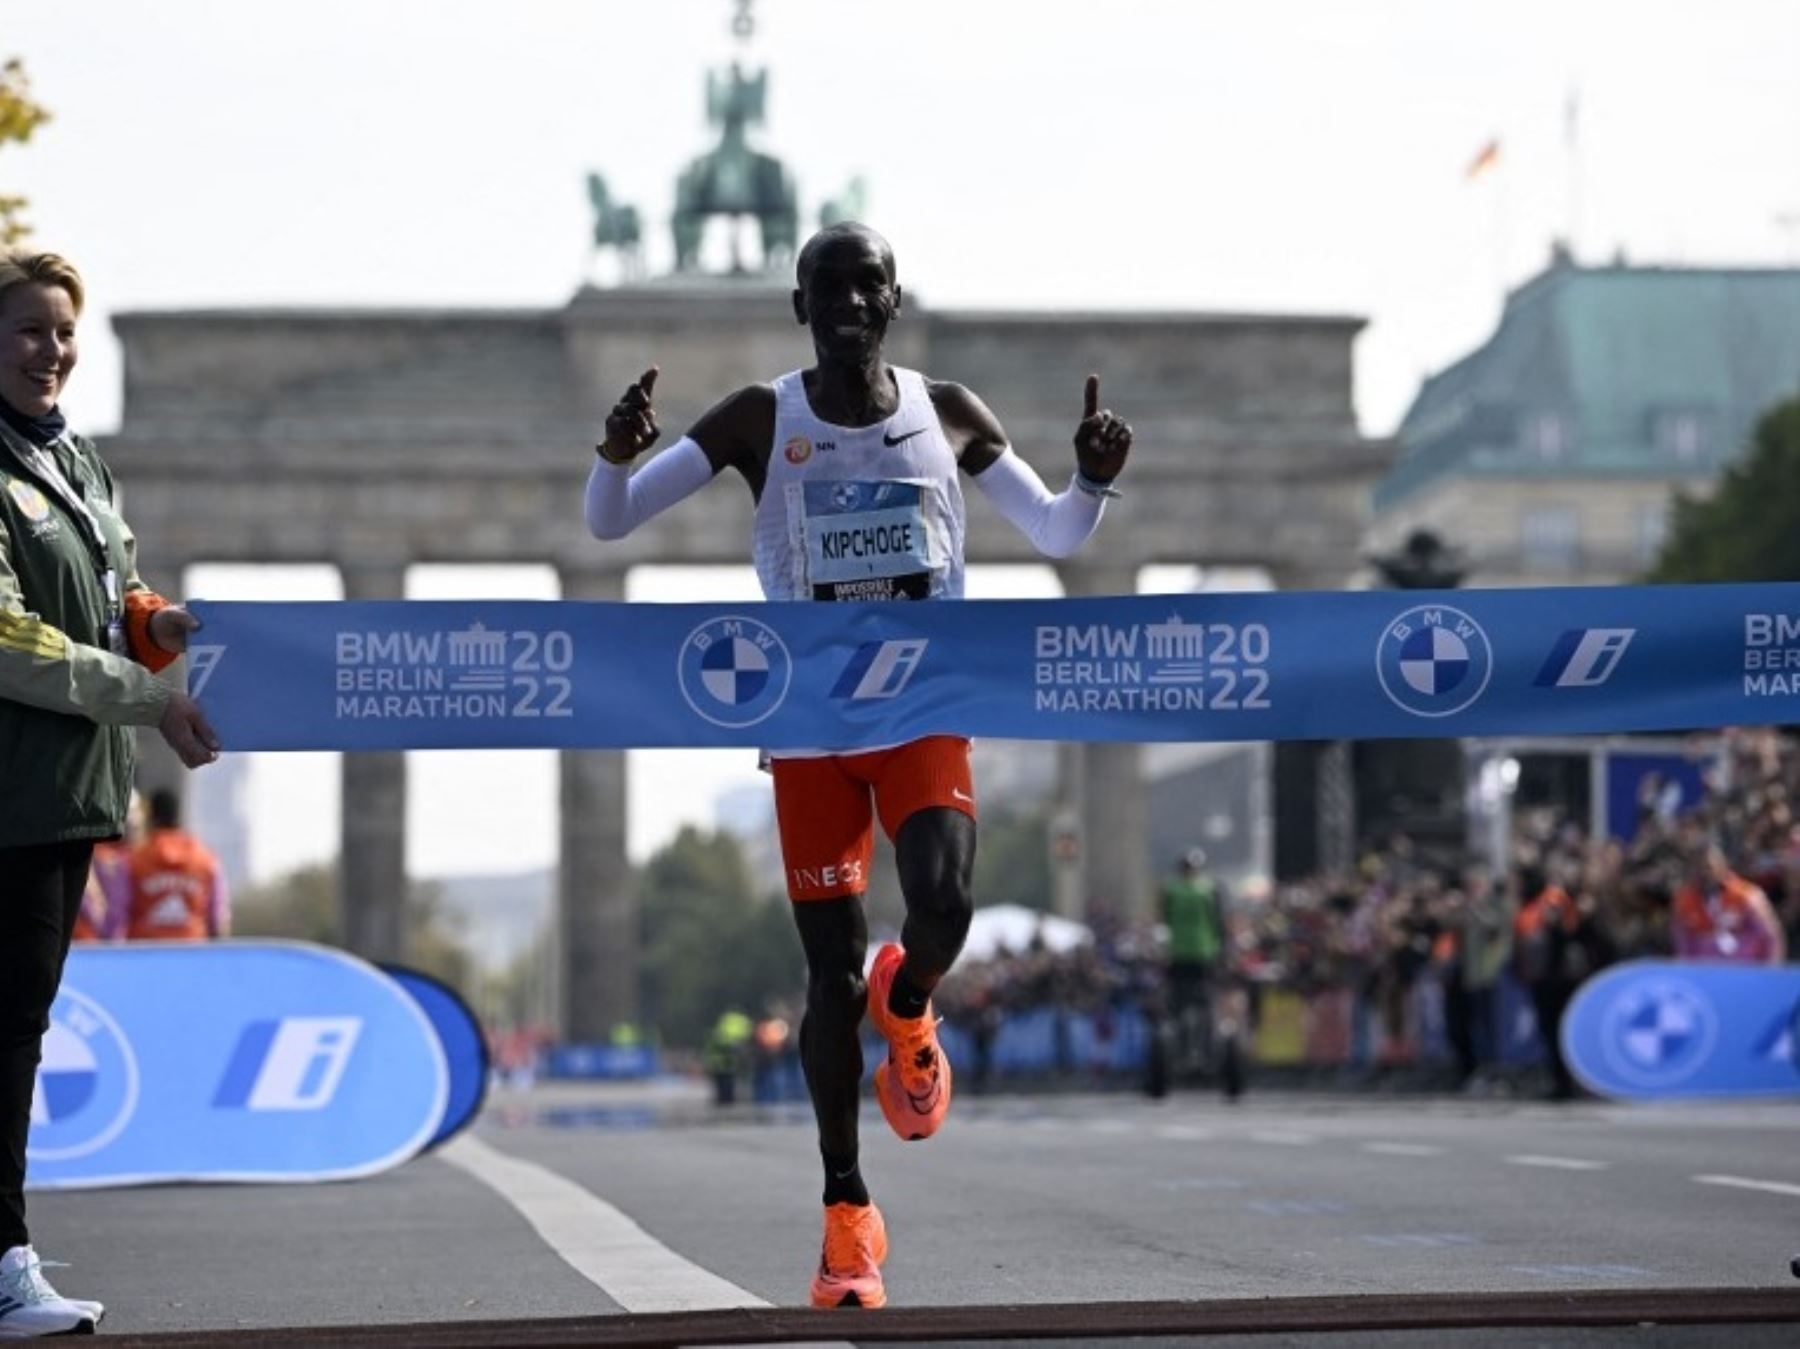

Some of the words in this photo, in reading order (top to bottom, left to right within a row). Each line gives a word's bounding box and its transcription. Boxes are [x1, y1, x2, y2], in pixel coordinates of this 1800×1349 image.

[821, 523, 913, 559] KIPCHOGE
[336, 631, 441, 665] BMW
[512, 630, 574, 672] 20
[1036, 624, 1139, 658] BMW
[1209, 623, 1270, 663] 20
[336, 668, 443, 691] BERLIN
[1036, 662, 1141, 684] BERLIN
[1209, 669, 1271, 709] 22
[336, 695, 506, 718] MARATHON
[512, 676, 574, 717] 22
[1036, 688, 1204, 711] MARATHON
